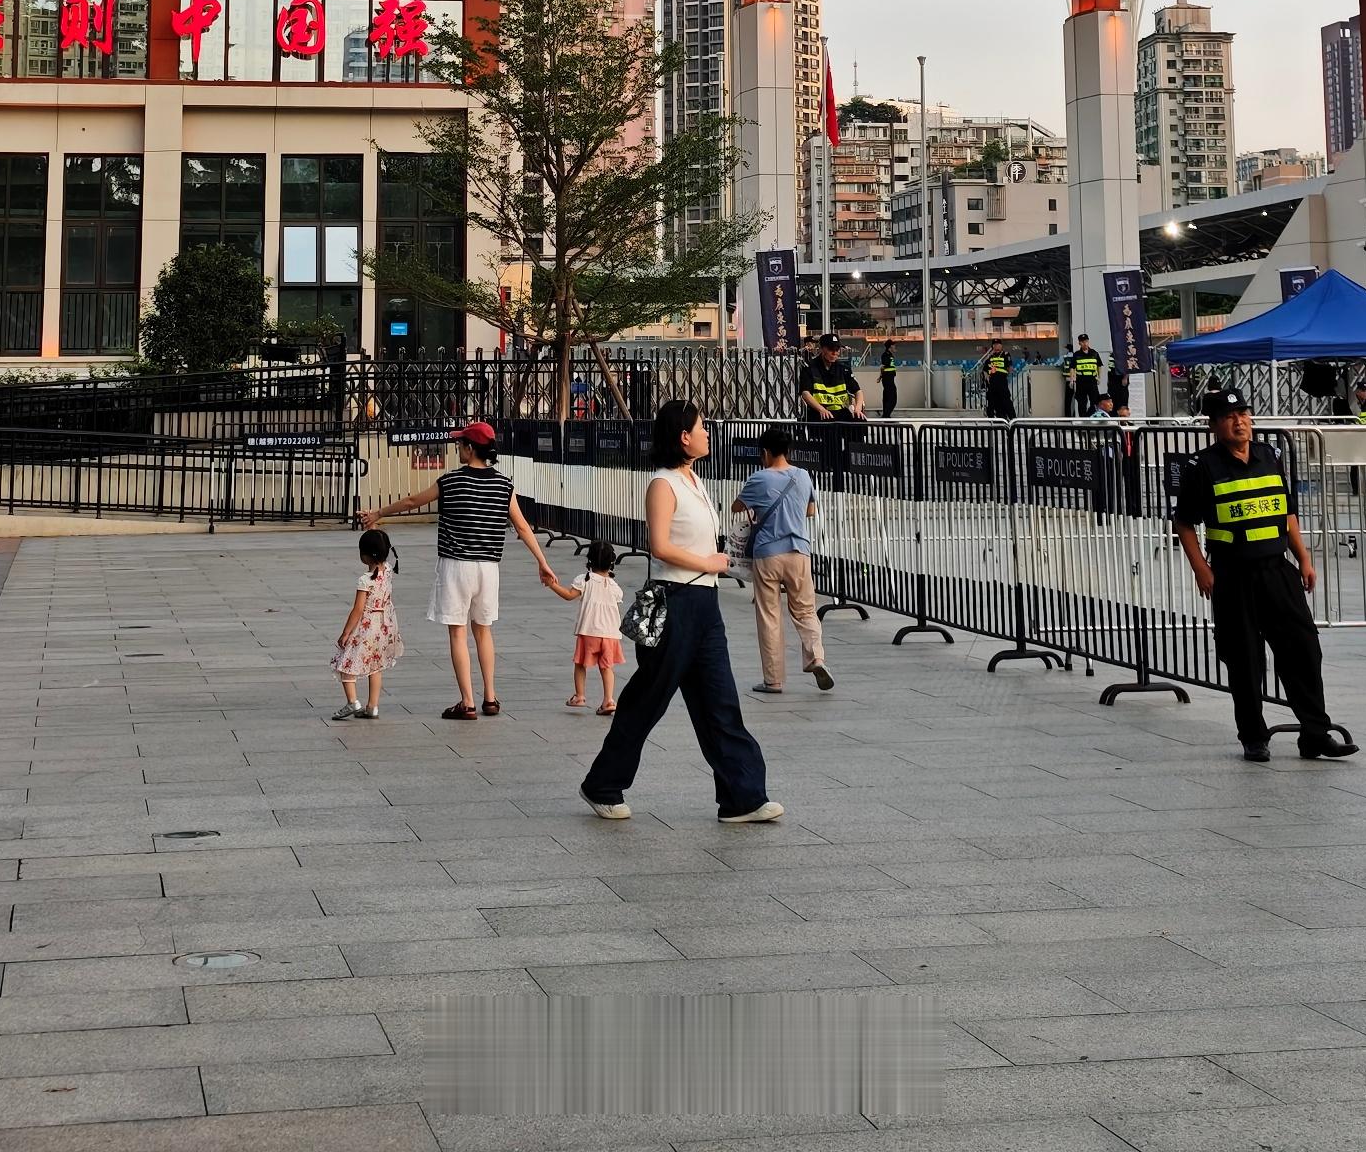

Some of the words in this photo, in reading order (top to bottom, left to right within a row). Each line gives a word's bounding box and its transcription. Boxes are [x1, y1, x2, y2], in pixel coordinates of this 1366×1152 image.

[946, 452, 974, 468] POLICE
[1047, 458, 1081, 478] POLICE
[1229, 498, 1280, 519] 越秀保安
